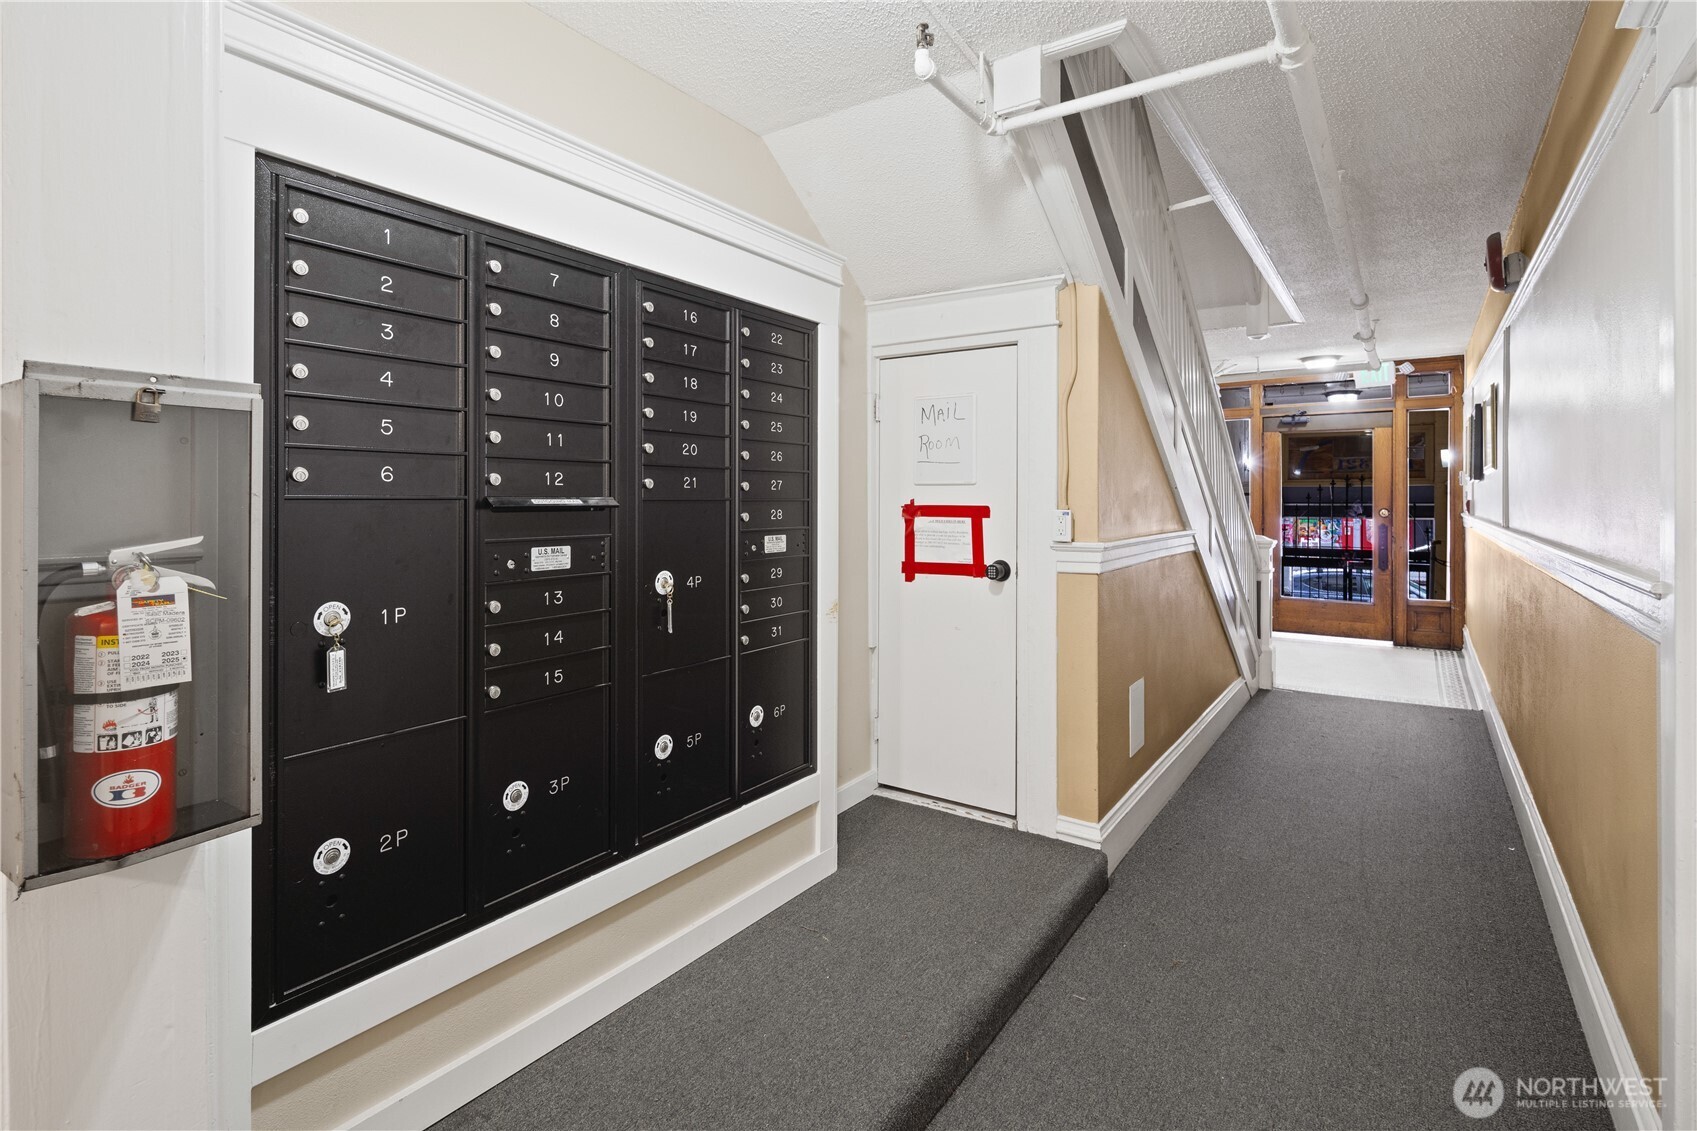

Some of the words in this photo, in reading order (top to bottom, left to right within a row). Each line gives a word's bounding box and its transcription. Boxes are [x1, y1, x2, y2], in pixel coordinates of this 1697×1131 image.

[380, 275, 394, 294] 2
[550, 272, 560, 287] 7
[549, 313, 560, 328] 8
[683, 309, 698, 324] 16
[380, 322, 394, 340] 3
[771, 332, 783, 346] 22
[683, 343, 698, 357] 17
[549, 352, 560, 367] 9
[771, 362, 783, 375] 23
[379, 371, 394, 388] 4
[683, 376, 698, 390] 18
[544, 392, 564, 407] 10
[770, 391, 783, 403] 24
[683, 410, 697, 423] 19
[380, 418, 394, 436] 5
[770, 421, 783, 433] 25
[546, 432, 563, 447] 11
[682, 443, 698, 456] 20
[770, 450, 783, 462] 26
[380, 465, 394, 483] 6
[545, 471, 564, 486] 12
[683, 476, 697, 489] 21
[770, 479, 783, 491] 27
[770, 508, 783, 520] 28
[537, 548, 550, 556] U.S.
[550, 547, 565, 555] MAIL
[770, 567, 783, 579] 29
[686, 575, 702, 588] 4P
[544, 590, 563, 606] 13
[770, 596, 783, 609] 30
[323, 603, 342, 613] OPEN
[381, 607, 407, 625] 1P
[544, 630, 564, 646] 14
[771, 625, 782, 638] 31
[131, 653, 150, 661] 2022
[161, 650, 180, 658] 2023
[161, 656, 180, 664] 2025
[131, 660, 150, 668] 2024
[544, 669, 564, 685] 15
[773, 704, 786, 718] 6P
[686, 732, 702, 748] 5P
[109, 781, 147, 791] BADGER
[549, 775, 570, 795] 3P
[323, 840, 342, 850] OPEN
[379, 828, 408, 853] 2P
